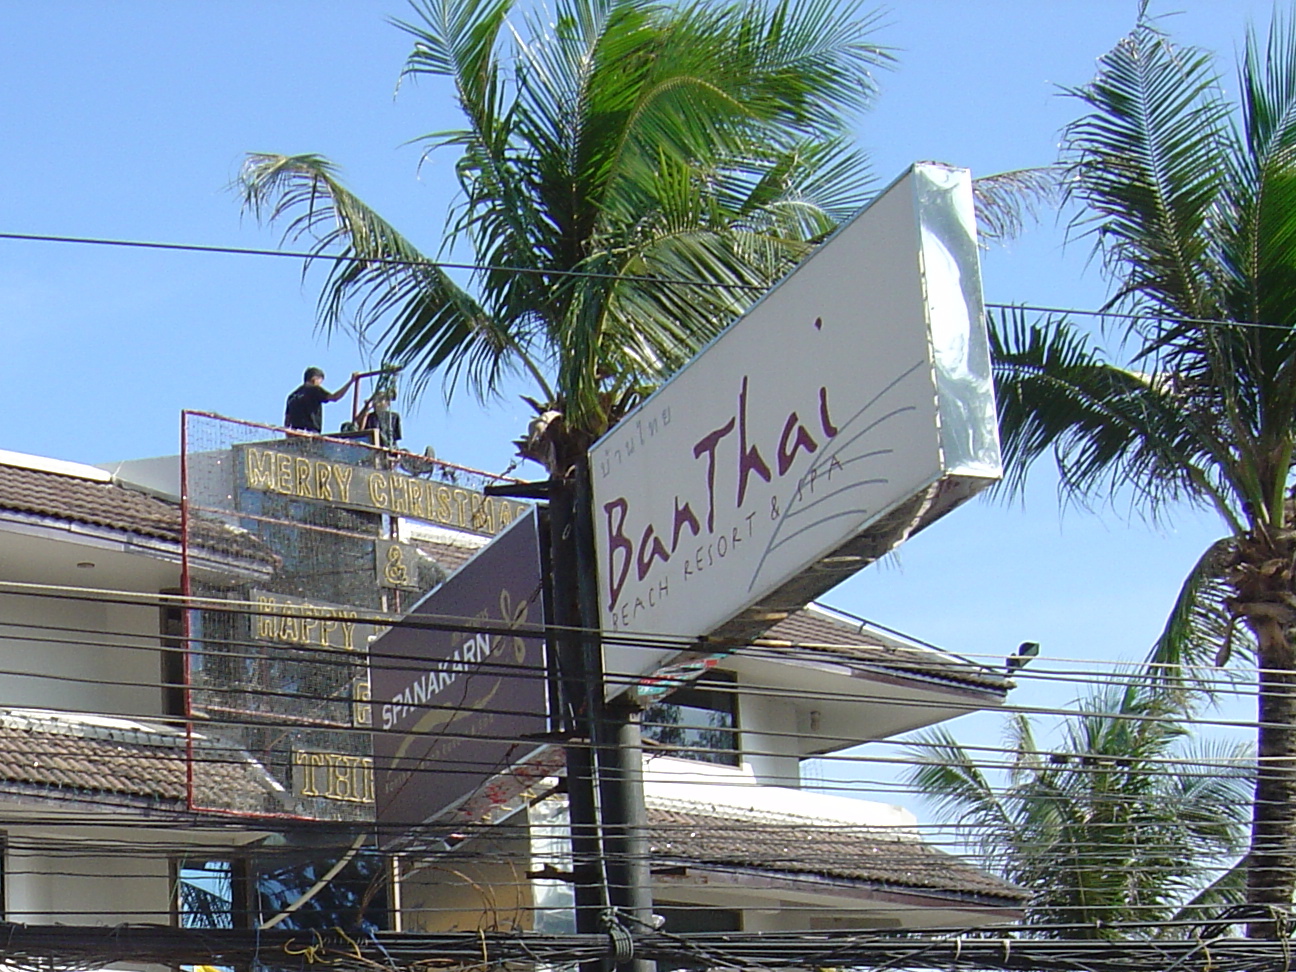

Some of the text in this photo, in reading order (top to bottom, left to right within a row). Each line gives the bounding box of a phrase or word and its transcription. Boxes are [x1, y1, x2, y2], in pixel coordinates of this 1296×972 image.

[245, 448, 353, 503] MERRY
[611, 453, 843, 631] BEACH RESORT & SPA
[257, 595, 358, 651] HAPPY
[381, 632, 491, 730] SPANAKARN
